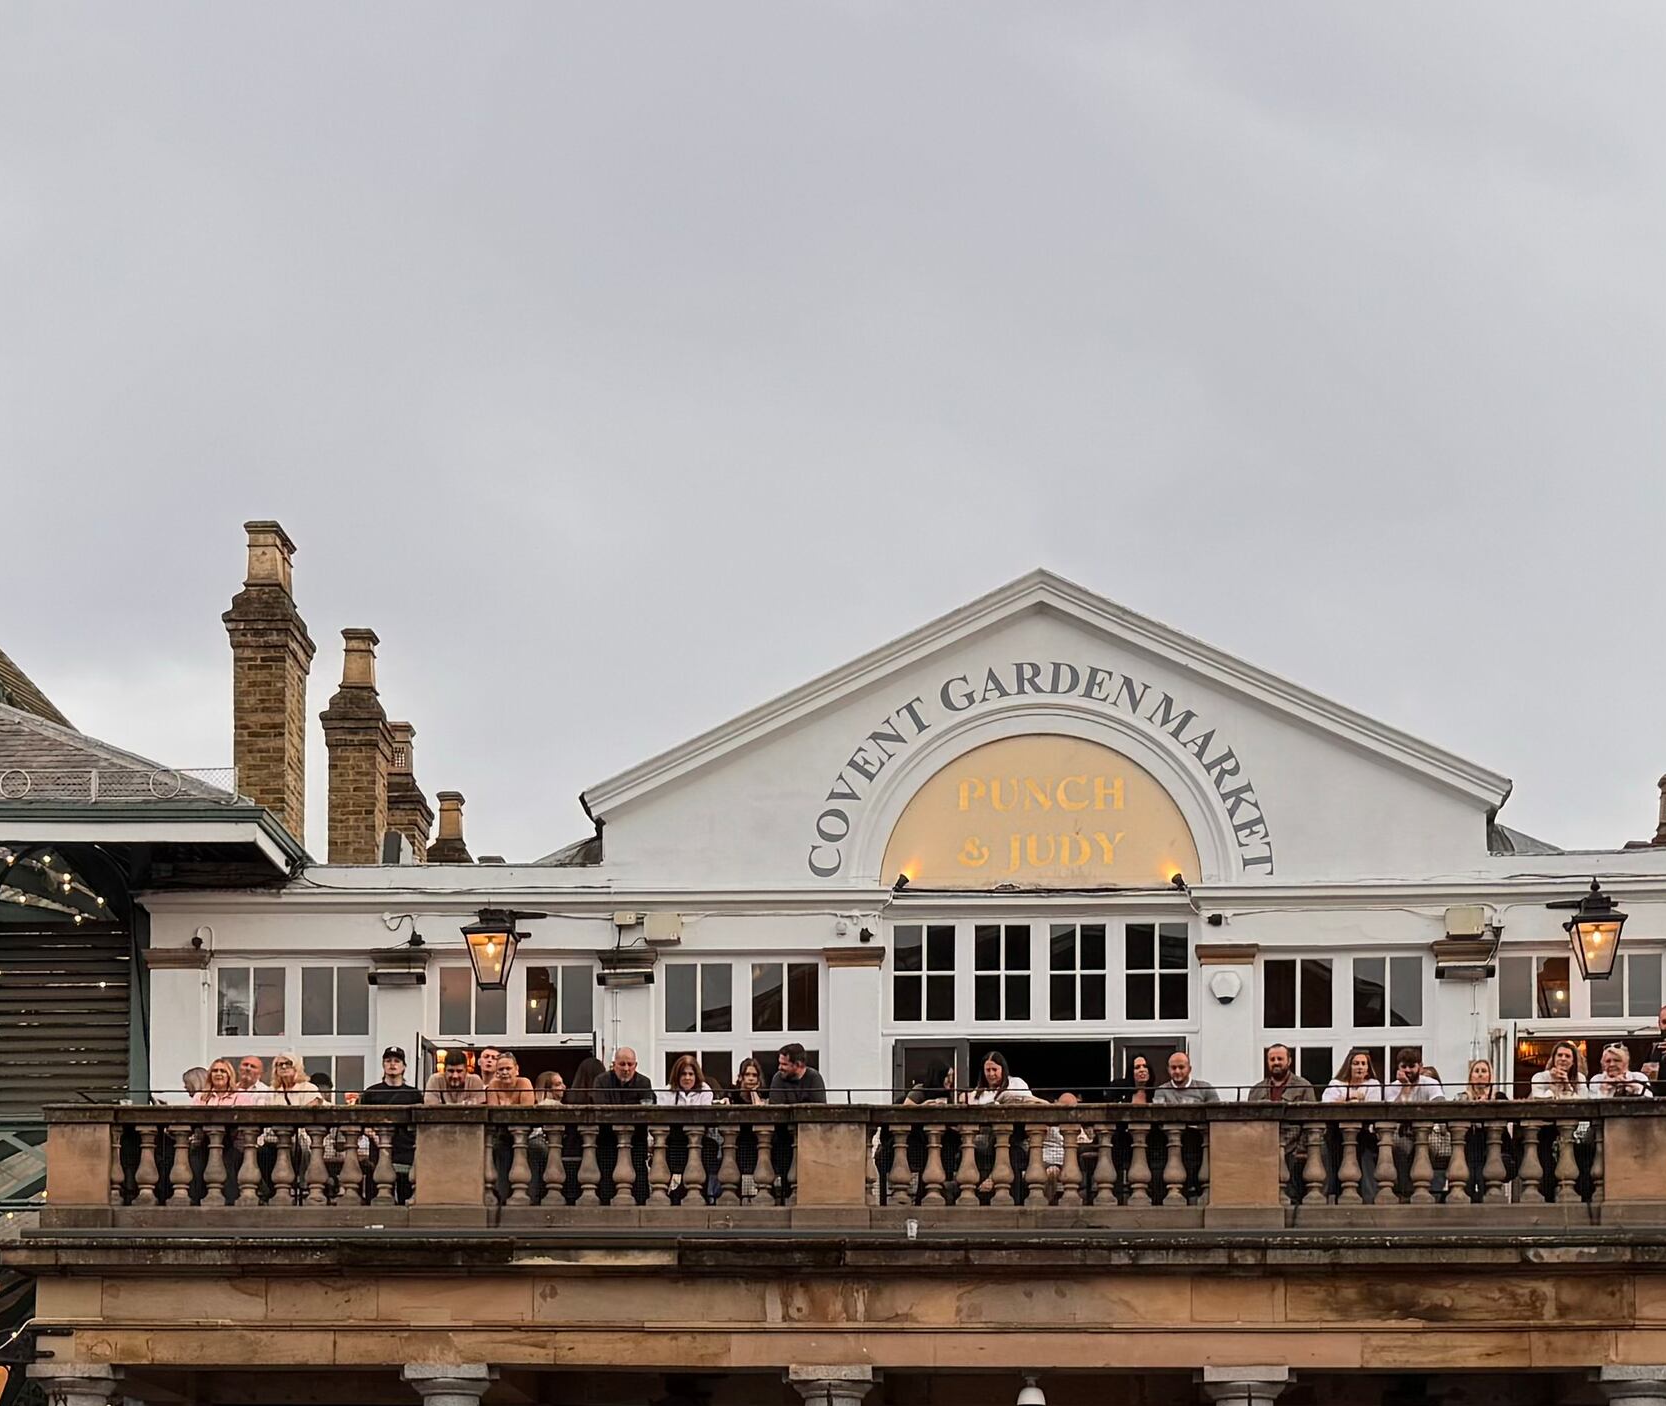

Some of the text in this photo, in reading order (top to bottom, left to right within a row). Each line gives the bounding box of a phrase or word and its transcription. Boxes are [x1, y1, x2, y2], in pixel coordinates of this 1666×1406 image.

[808, 661, 1275, 878] COVENT GARDEN MARKET
[958, 774, 1126, 812] PUNCH
[957, 831, 1126, 874] & JUDY
